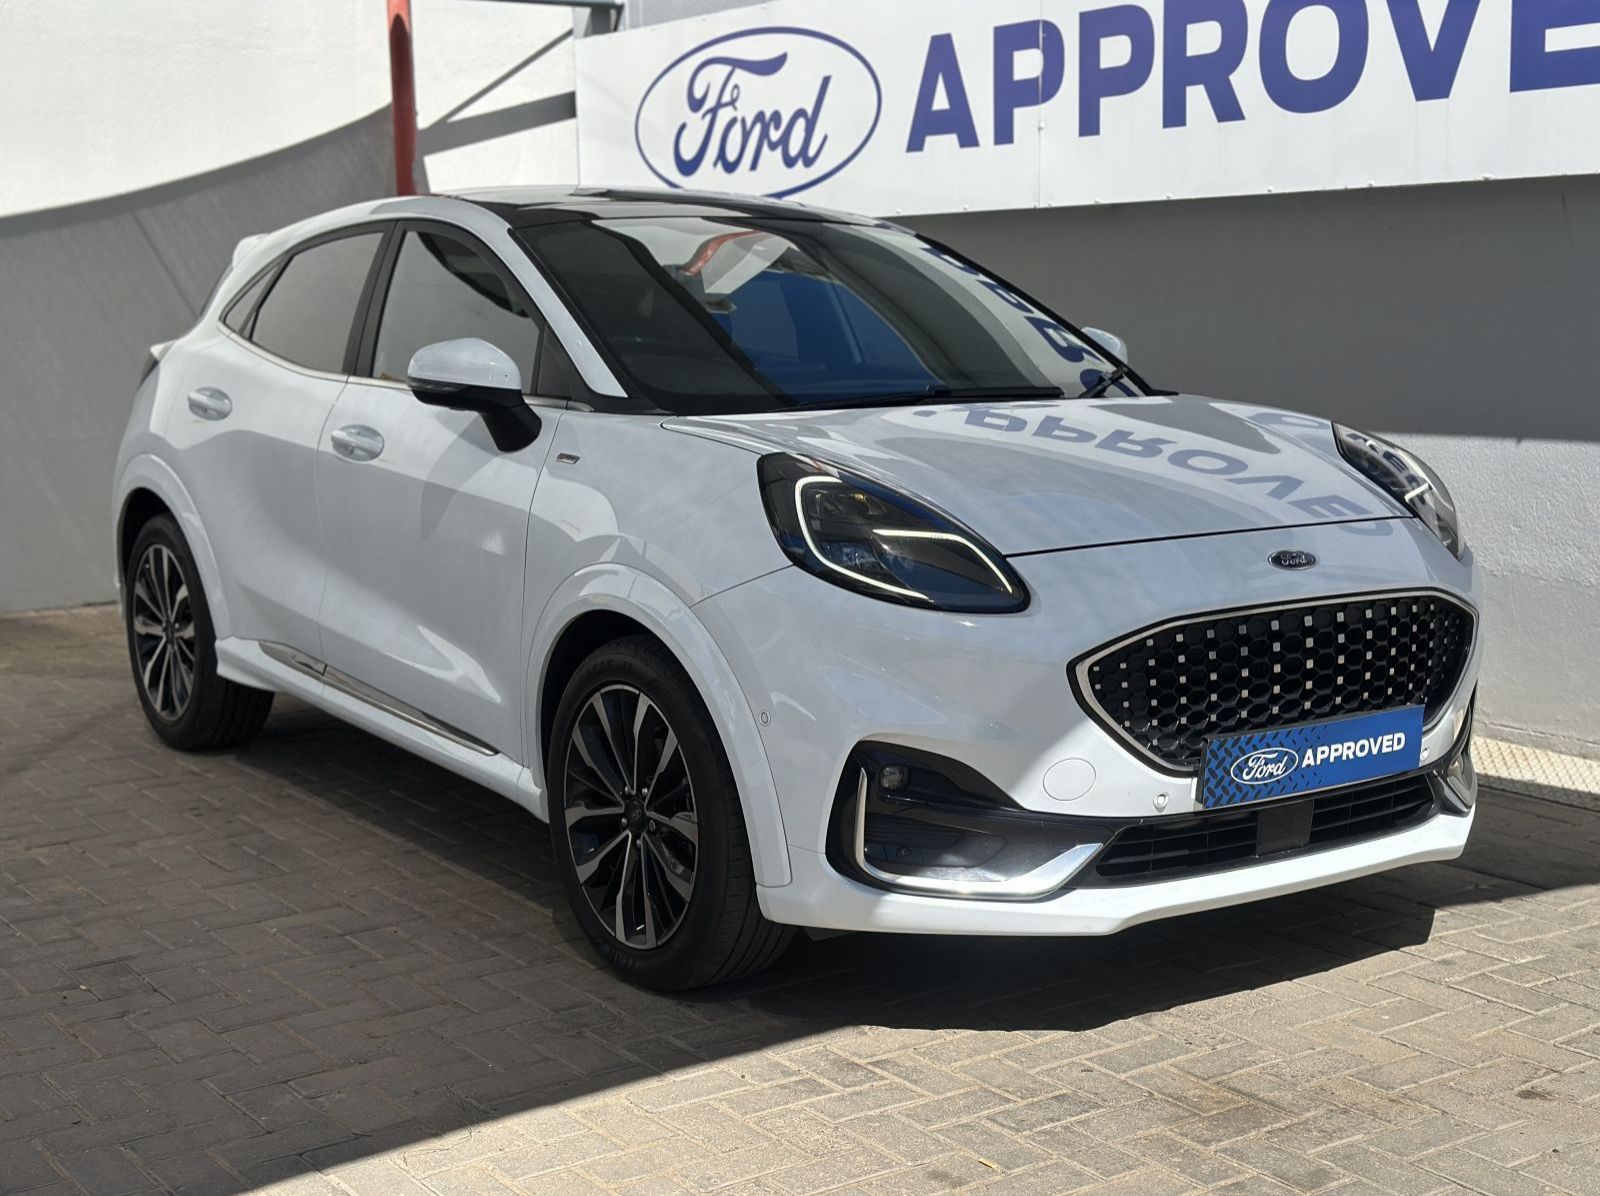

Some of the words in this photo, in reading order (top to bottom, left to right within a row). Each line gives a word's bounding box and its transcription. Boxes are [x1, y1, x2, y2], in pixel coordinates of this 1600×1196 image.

[673, 51, 833, 177] Ford
[905, 0, 1600, 153] APPROVE
[1242, 752, 1289, 781] Ford
[1301, 731, 1406, 768] APPROVED
